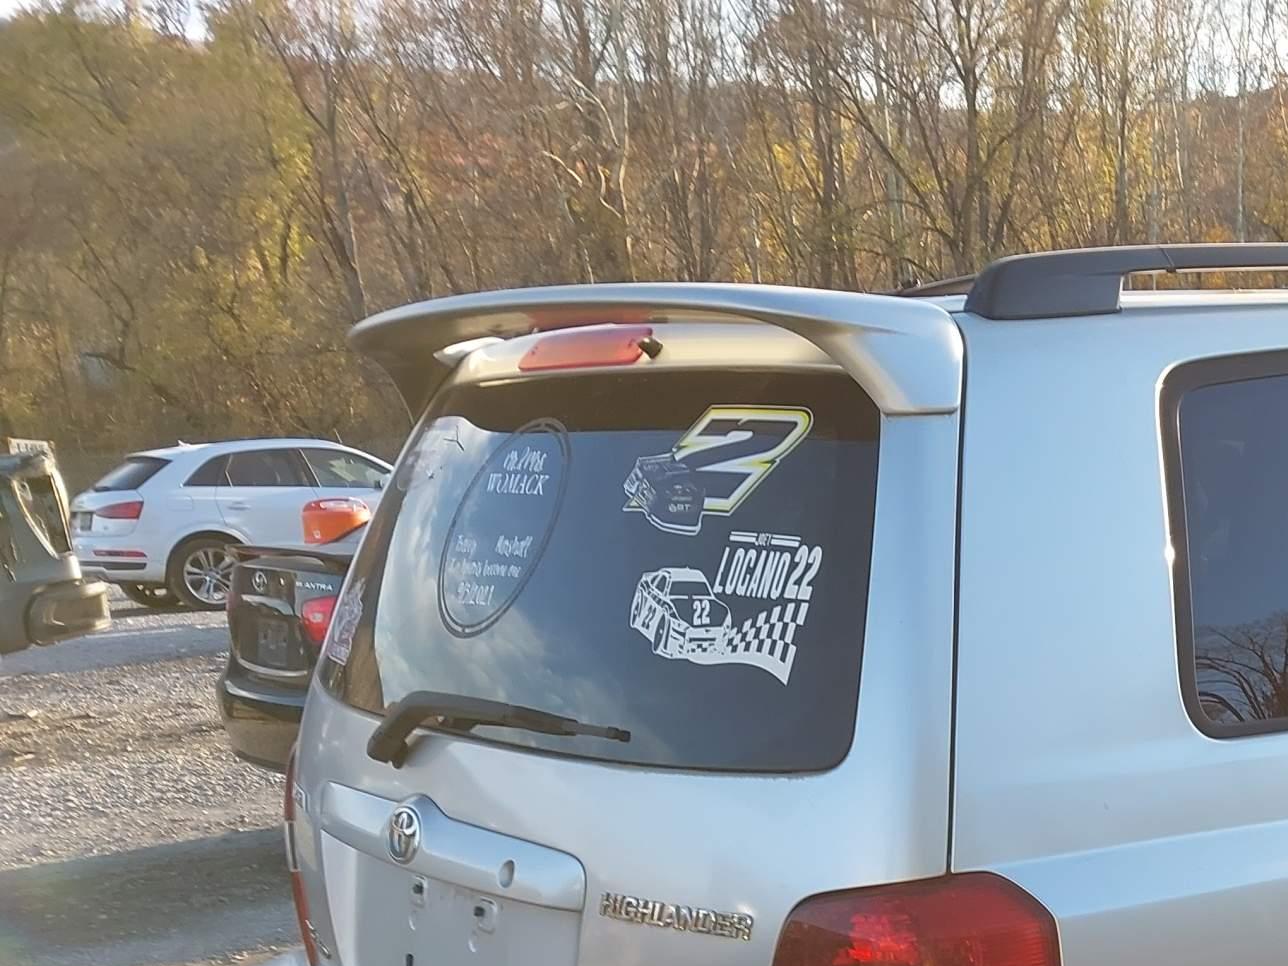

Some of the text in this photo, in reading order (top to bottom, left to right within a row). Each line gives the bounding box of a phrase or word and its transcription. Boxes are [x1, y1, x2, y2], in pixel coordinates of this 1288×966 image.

[487, 473, 550, 495] WOMACK
[713, 544, 823, 601] LOGANO 22
[692, 599, 711, 626] 22
[599, 891, 755, 941] HIGHLANDER
